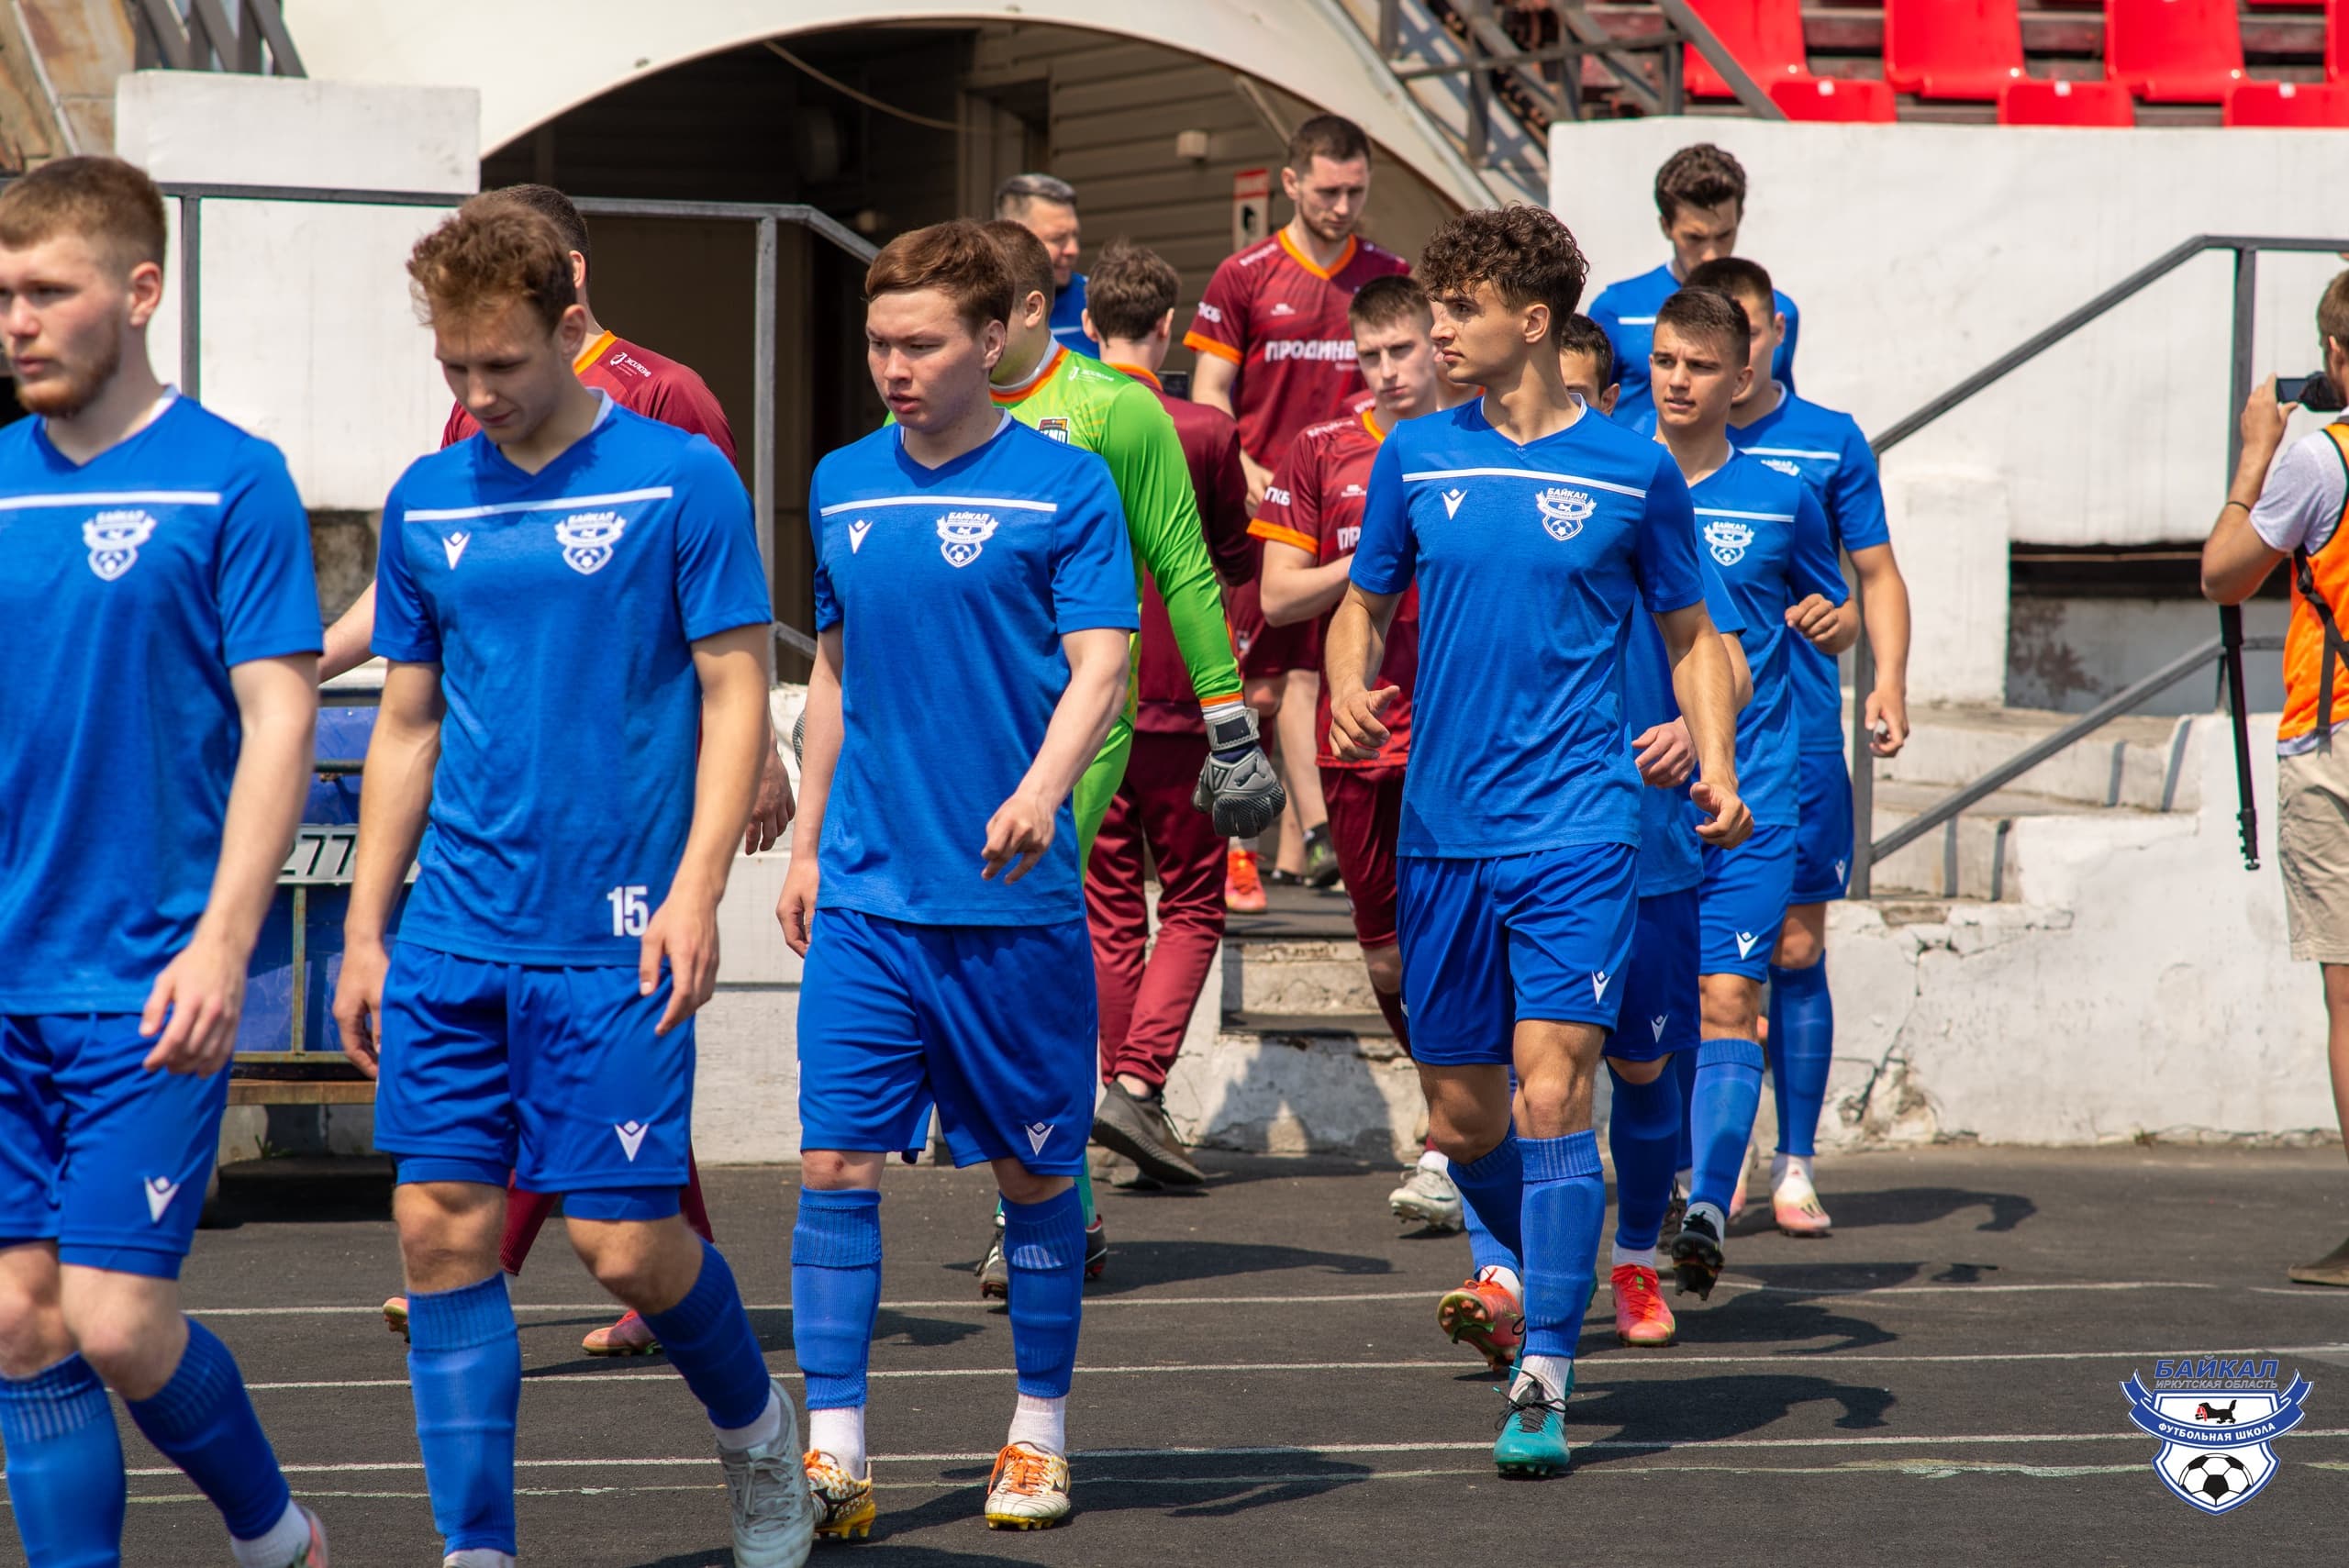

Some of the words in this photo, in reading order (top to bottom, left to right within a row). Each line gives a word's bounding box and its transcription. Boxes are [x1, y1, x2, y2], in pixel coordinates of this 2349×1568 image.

[1264, 485, 1291, 506] ПКБ
[1547, 487, 1588, 500] БАЙКАЛ
[607, 885, 649, 937] 15
